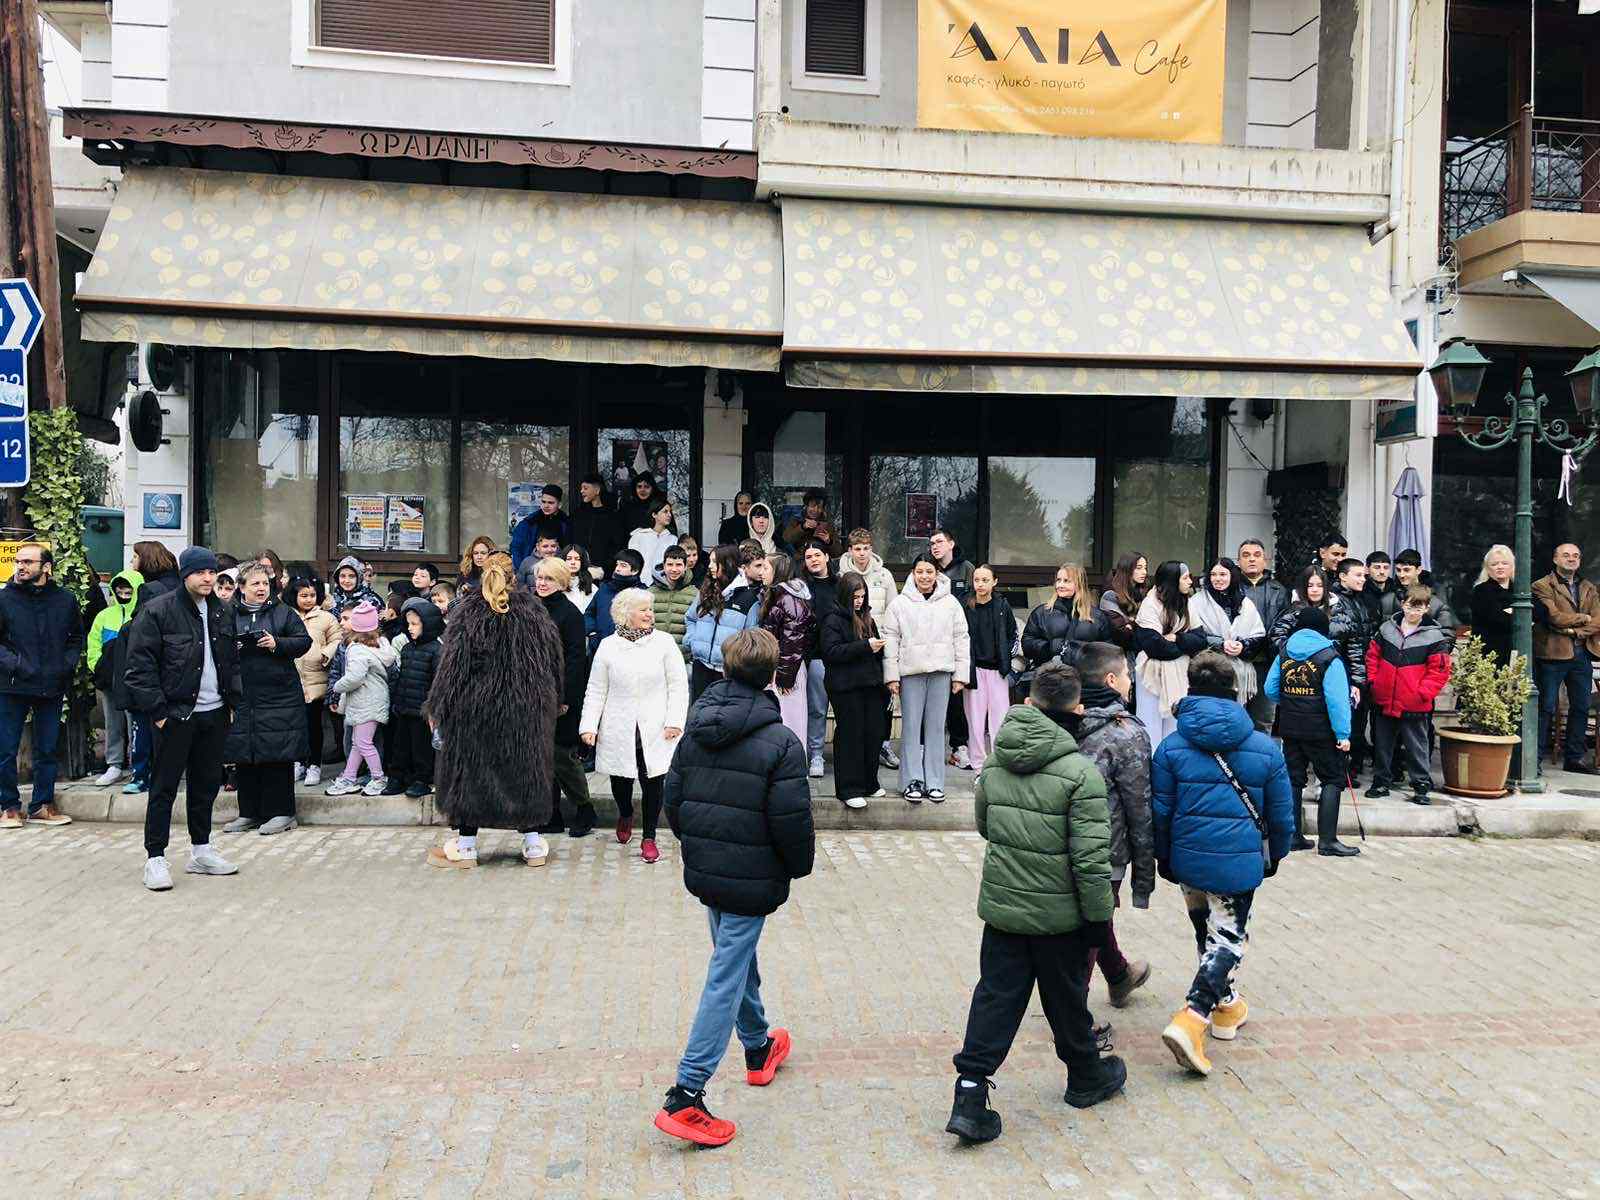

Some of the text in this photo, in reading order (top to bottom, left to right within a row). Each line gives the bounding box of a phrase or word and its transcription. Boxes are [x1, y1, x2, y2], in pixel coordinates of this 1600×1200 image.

[1134, 39, 1192, 84] Cafe
[946, 72, 984, 89] καφές
[994, 71, 1031, 90] γλυκό
[1041, 78, 1086, 94] παγωτό
[1, 438, 22, 458] 12
